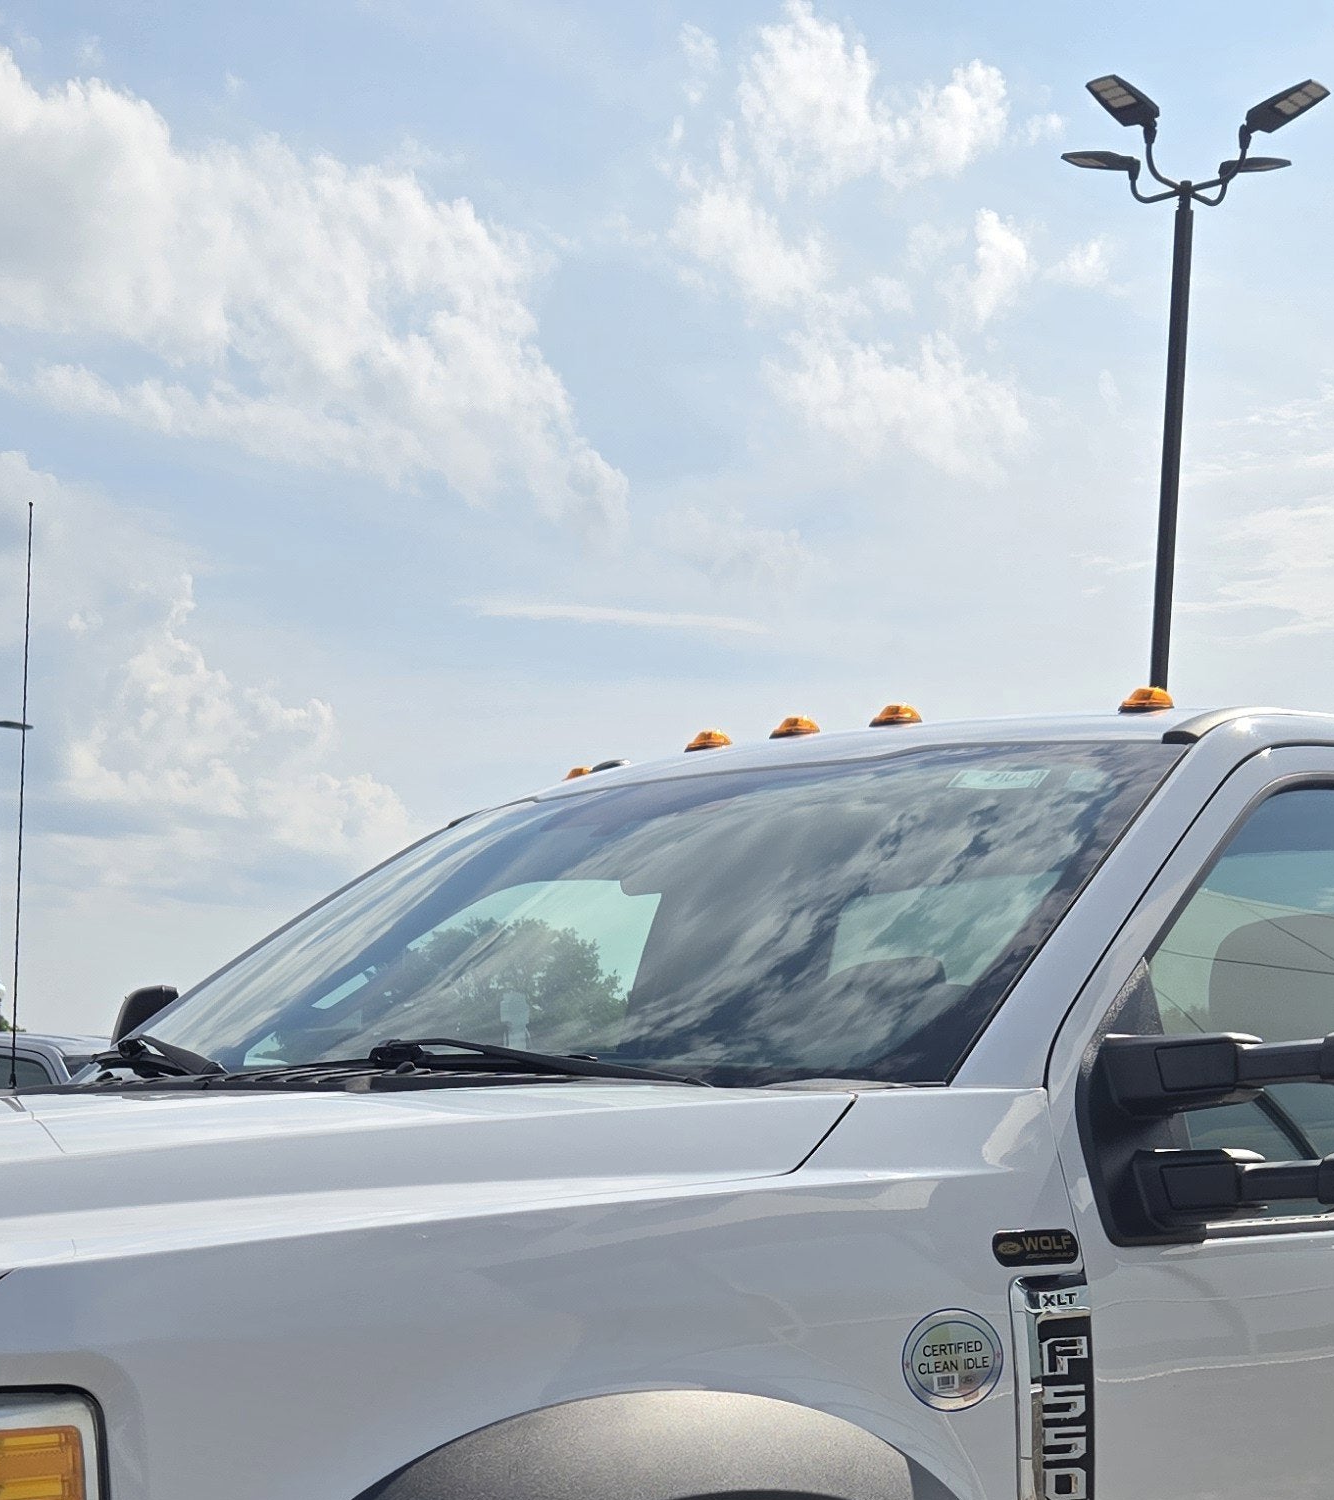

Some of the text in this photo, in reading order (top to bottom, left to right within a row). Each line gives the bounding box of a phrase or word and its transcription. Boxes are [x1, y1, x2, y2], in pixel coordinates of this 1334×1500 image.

[1022, 1234, 1072, 1252] WOLF
[1042, 1292, 1077, 1307] XLT
[923, 1340, 983, 1358] CERTIFIED
[918, 1356, 990, 1375] CLEAN IDLE
